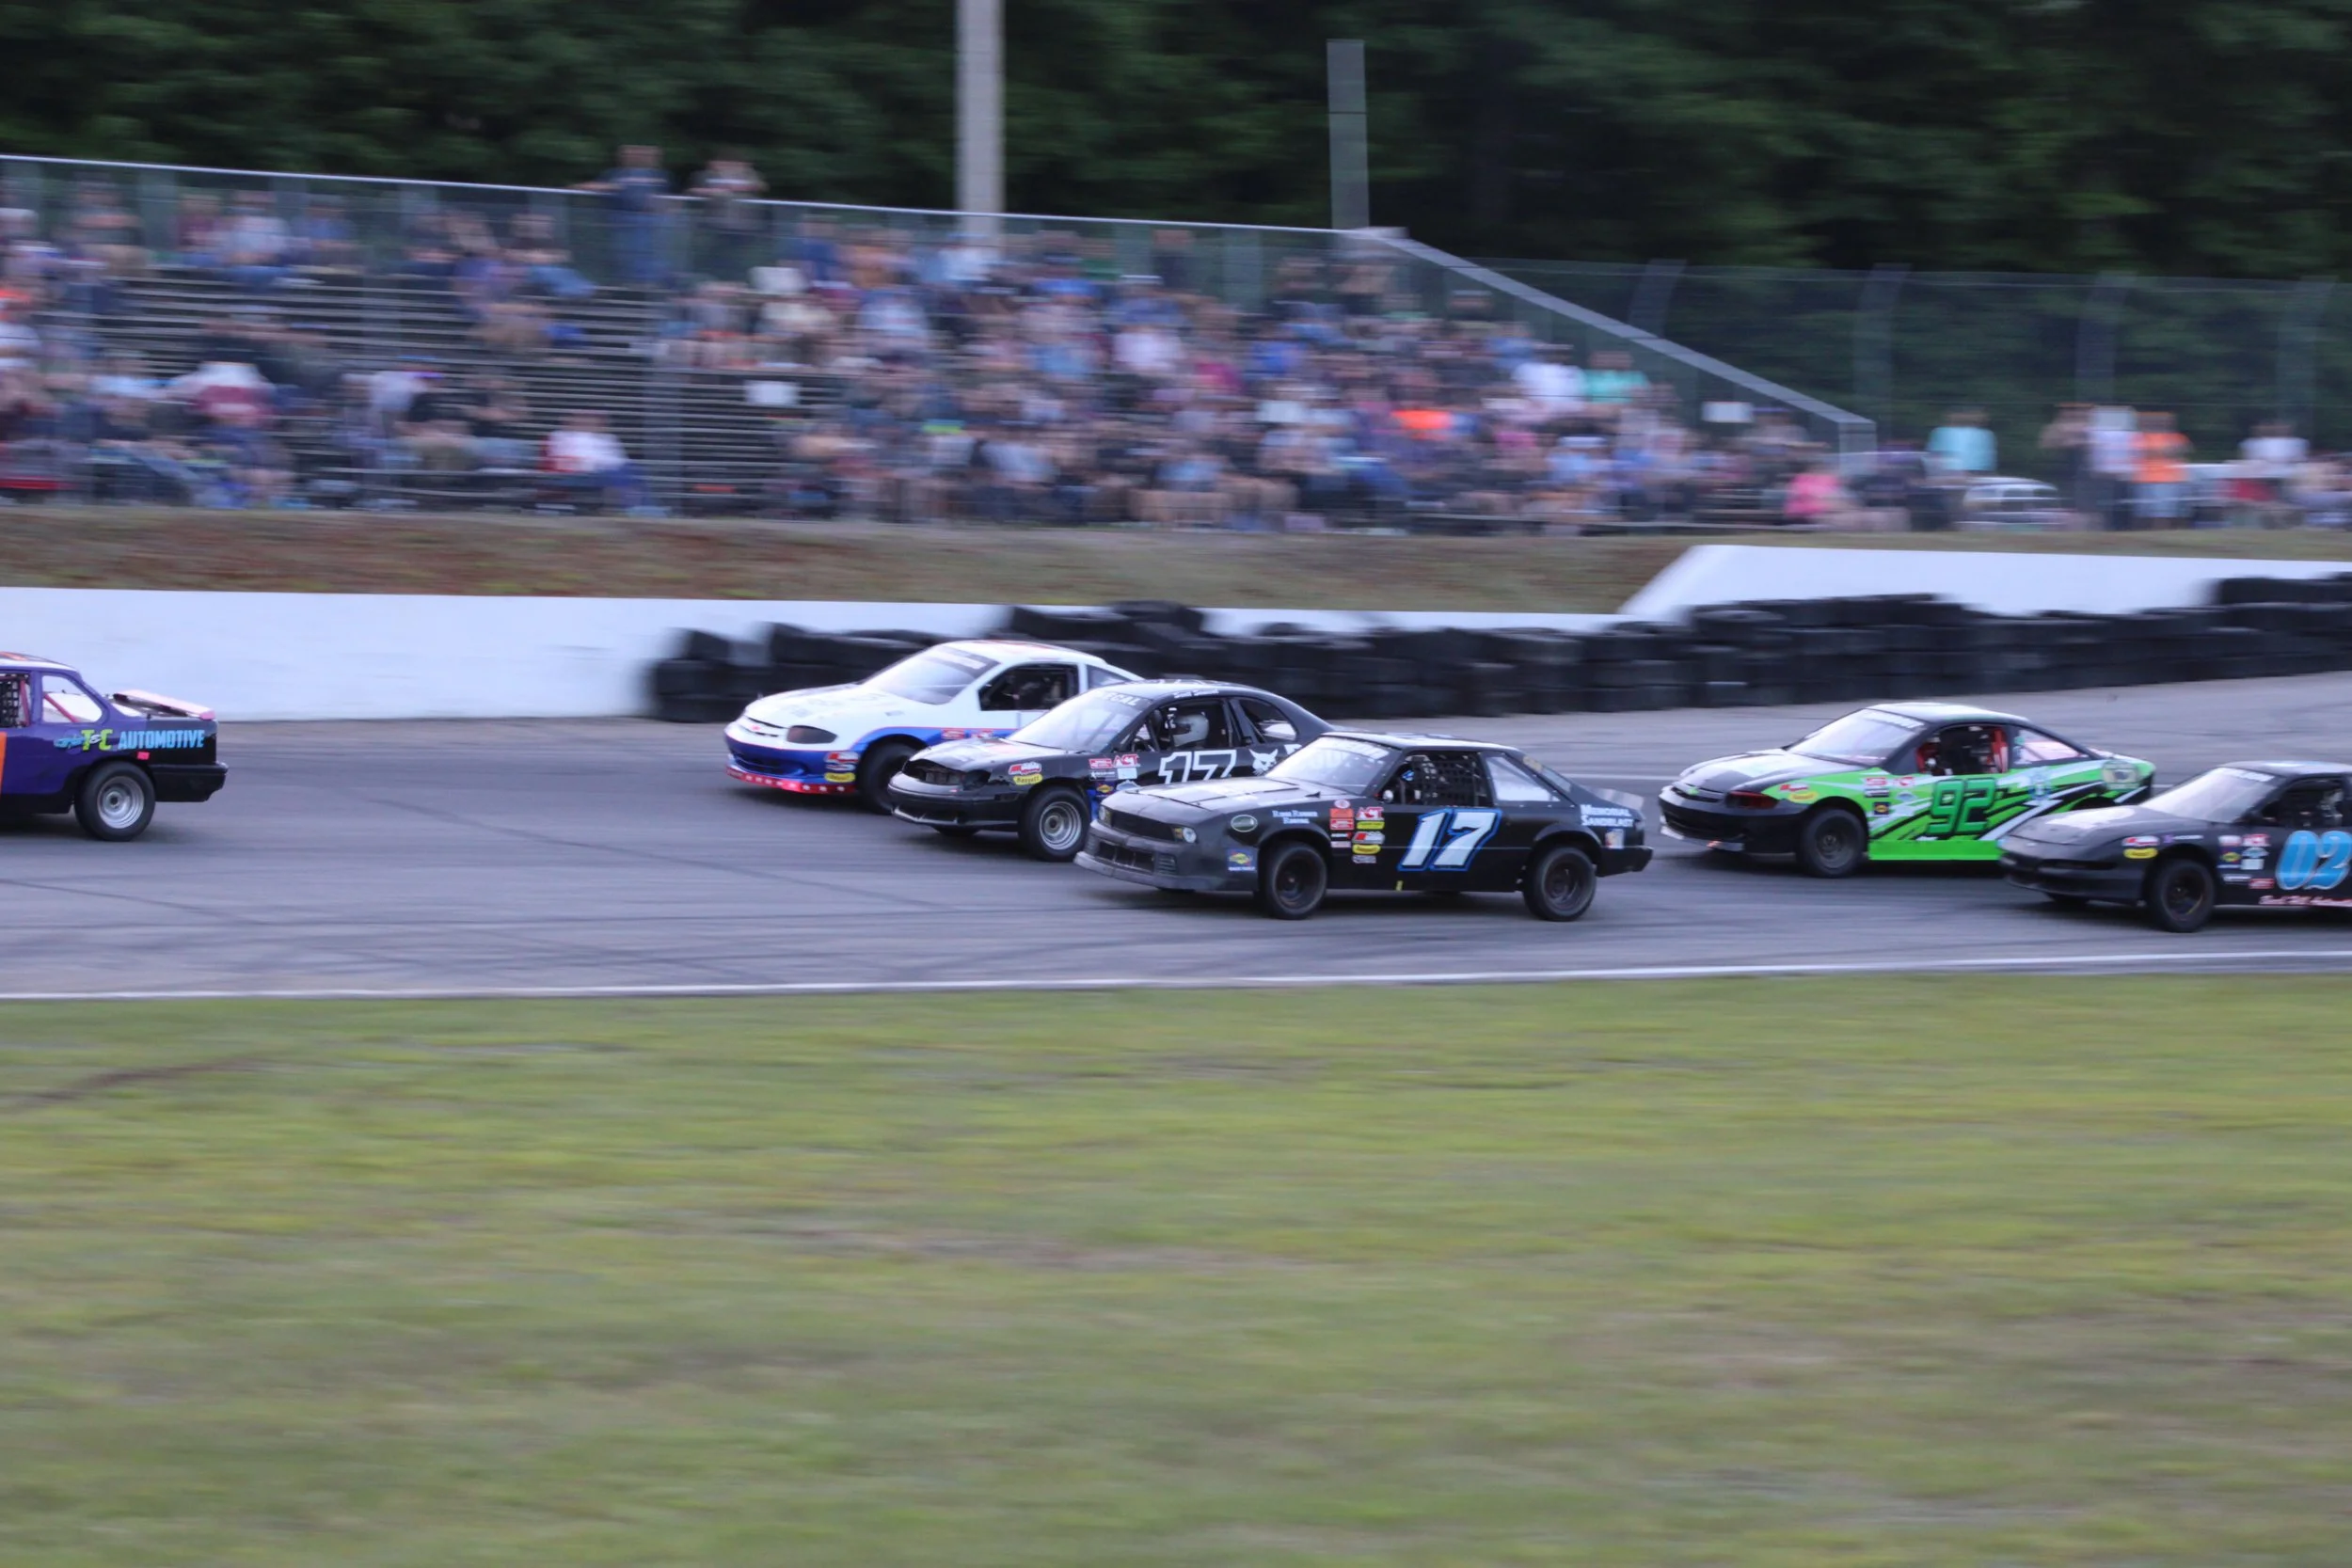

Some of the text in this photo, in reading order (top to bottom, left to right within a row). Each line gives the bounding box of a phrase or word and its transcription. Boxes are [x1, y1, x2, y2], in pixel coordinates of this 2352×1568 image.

[118, 730, 205, 749] AUTOMOTIVE
[1158, 749, 1237, 785] 17
[1926, 778, 1995, 835] 92
[1397, 808, 1502, 872] 17
[2276, 831, 2352, 891] 02
